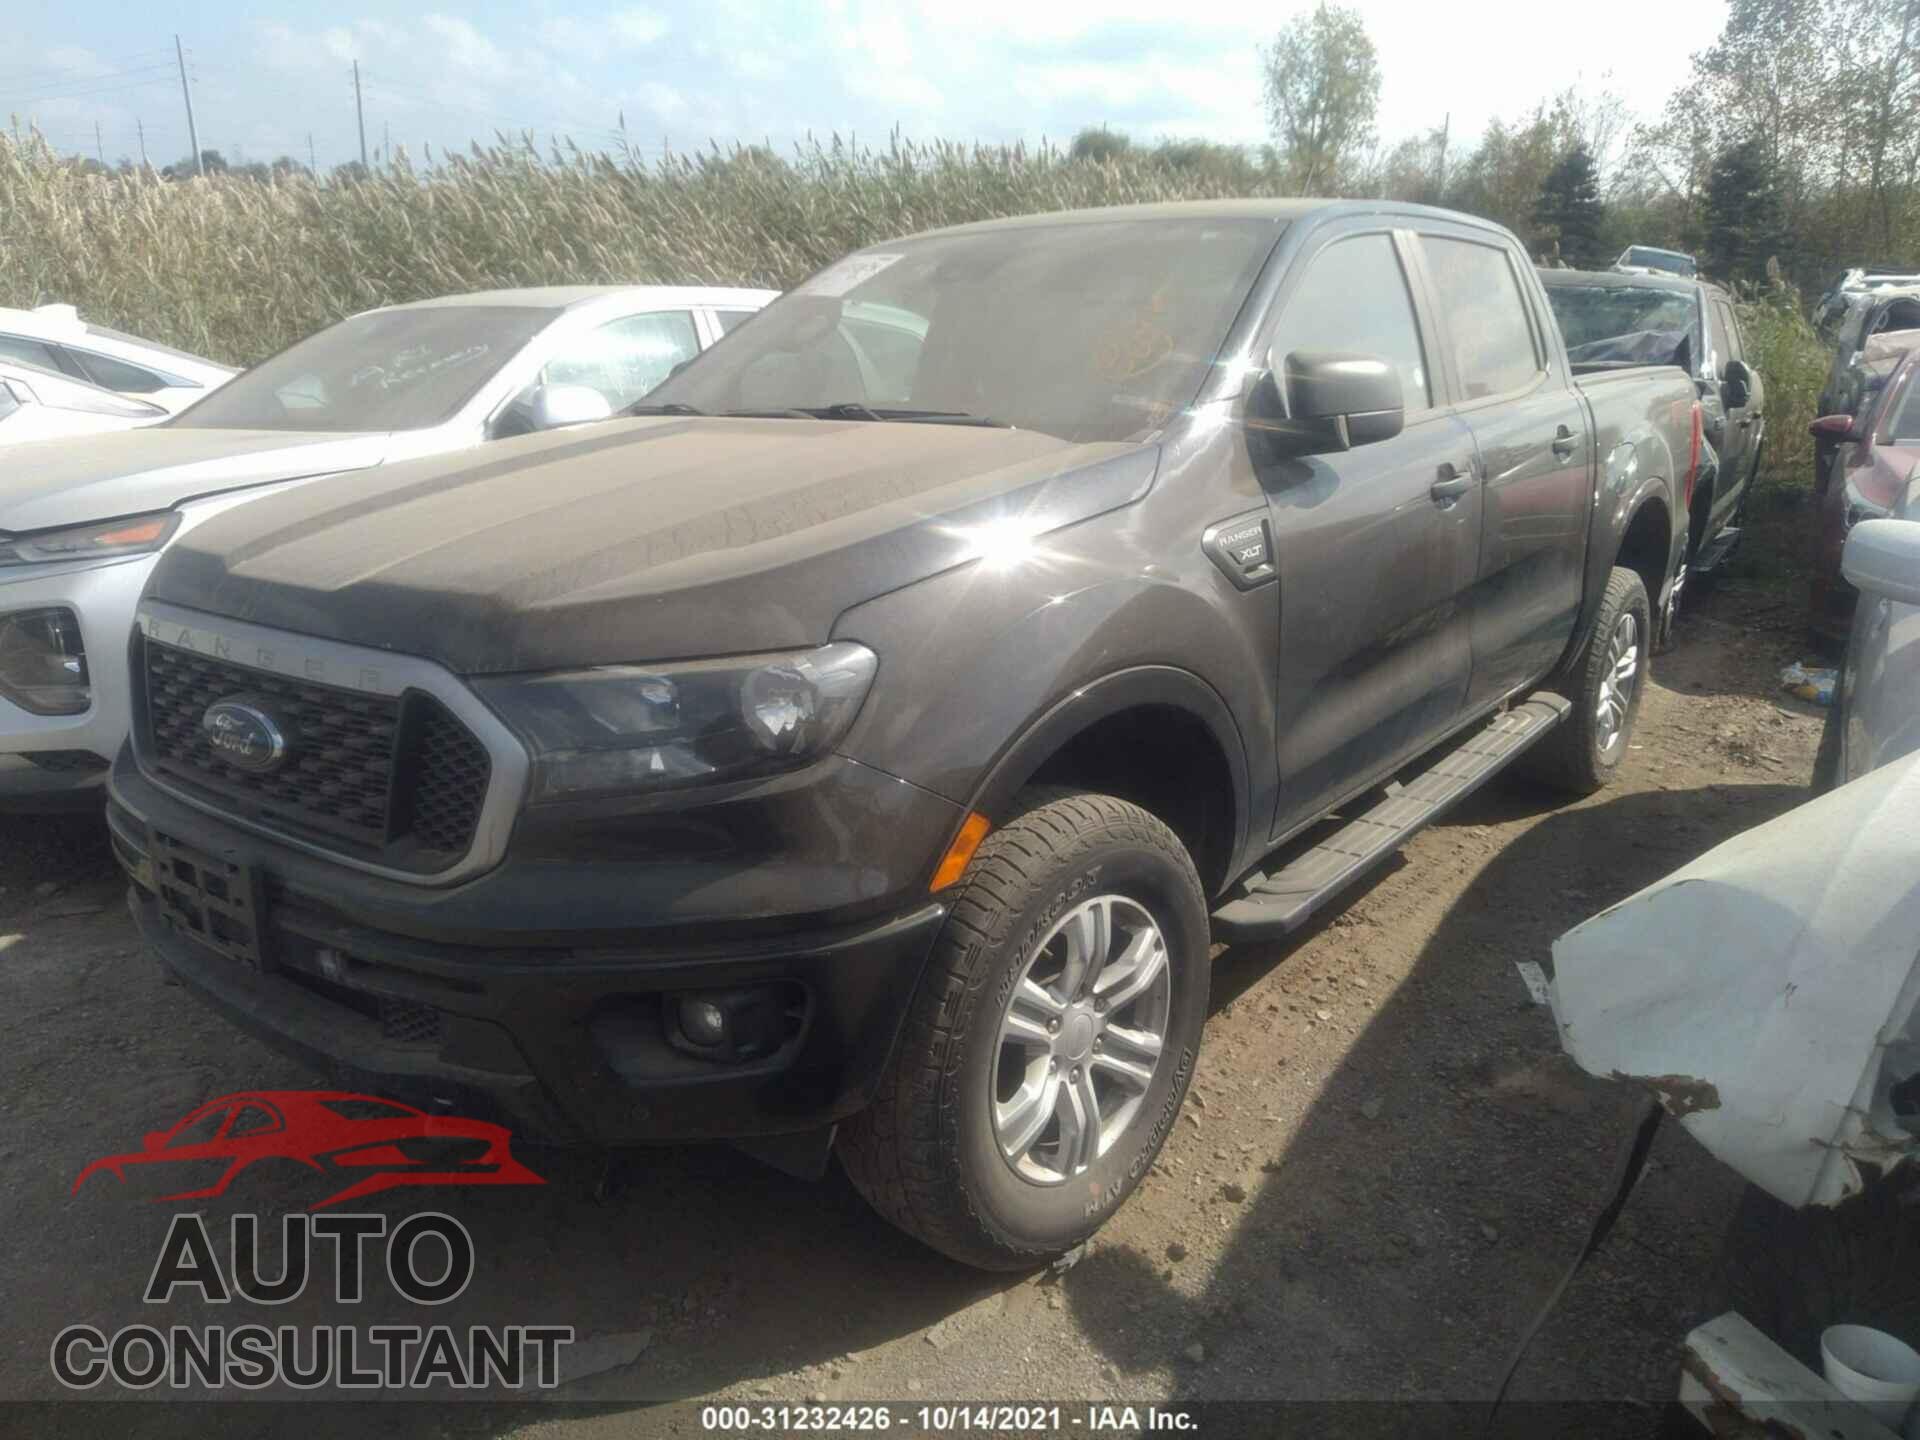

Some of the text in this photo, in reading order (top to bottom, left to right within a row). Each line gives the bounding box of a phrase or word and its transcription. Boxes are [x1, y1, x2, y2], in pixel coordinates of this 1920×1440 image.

[1240, 544, 1262, 560] XLT
[147, 616, 383, 690] RANGER
[209, 713, 257, 756] Ford
